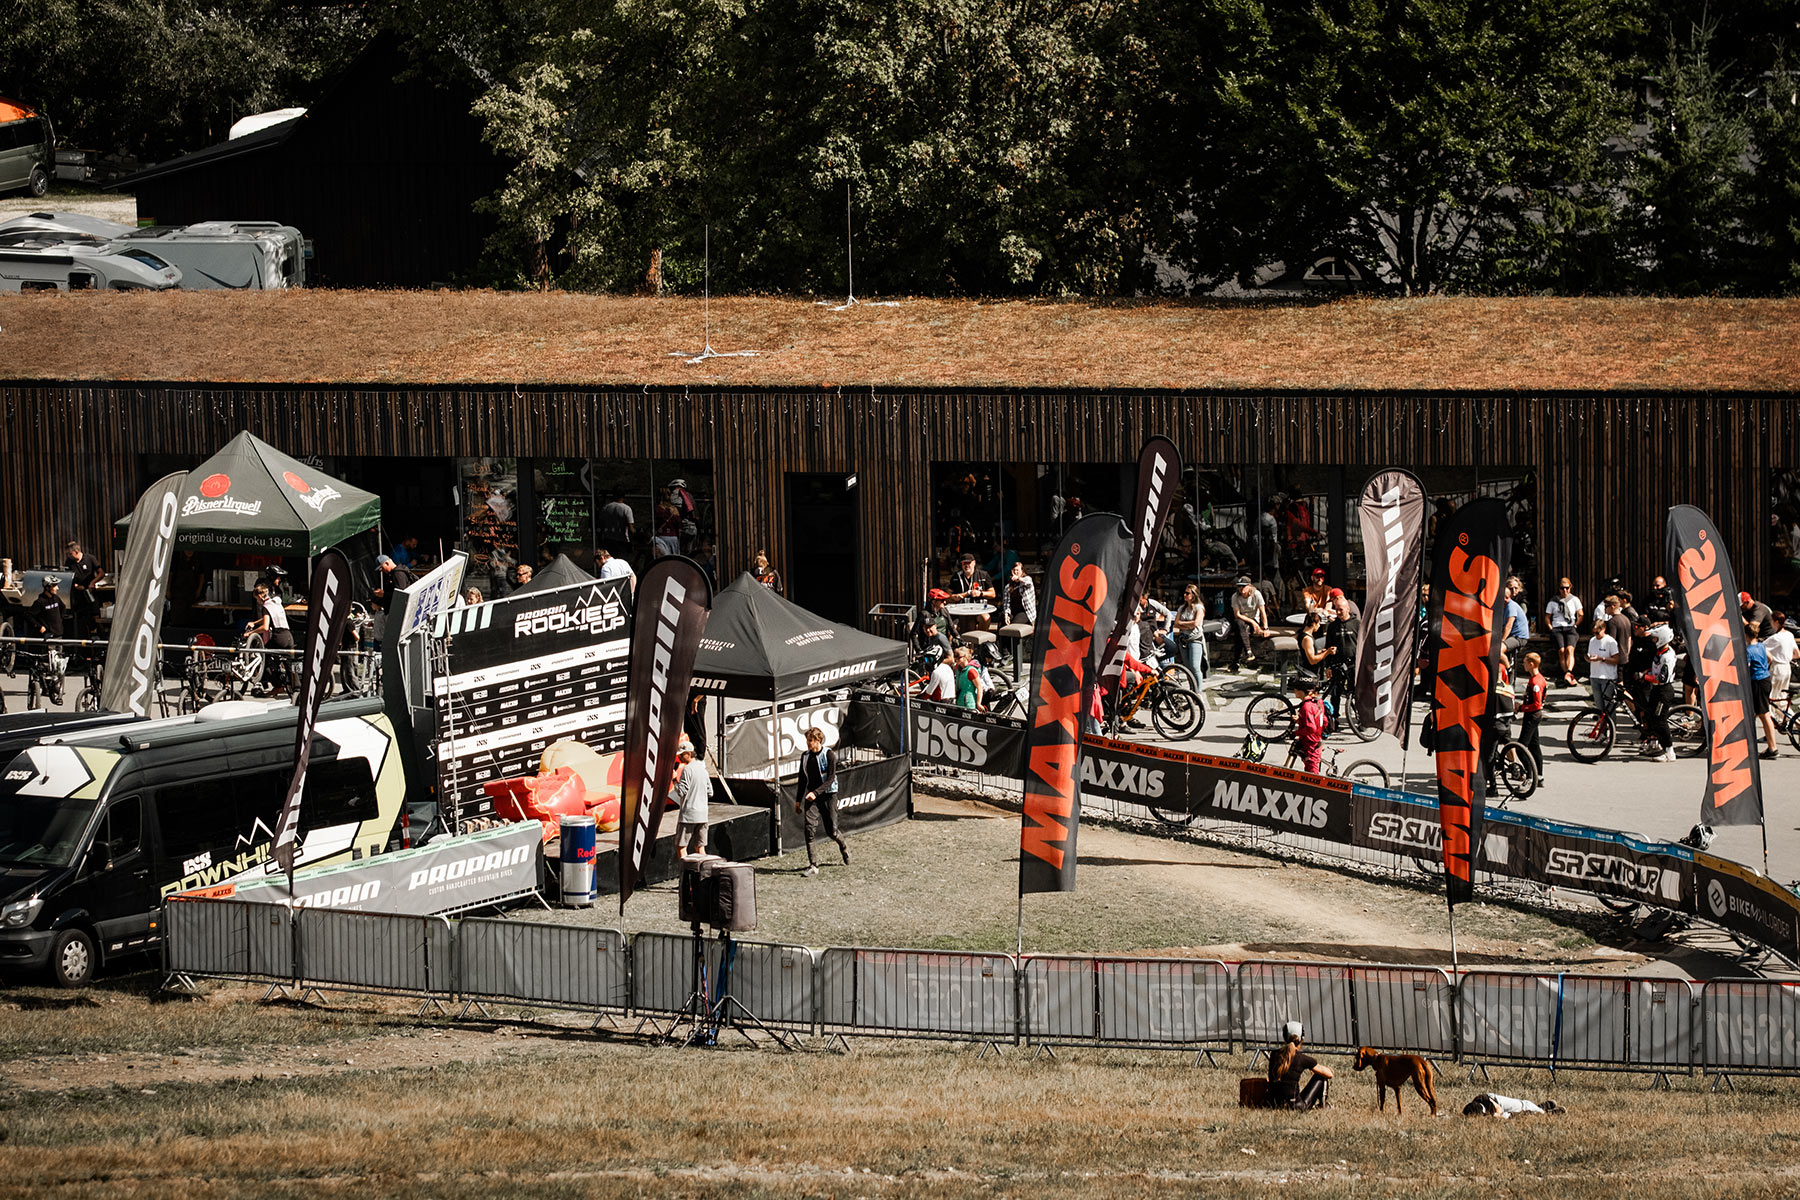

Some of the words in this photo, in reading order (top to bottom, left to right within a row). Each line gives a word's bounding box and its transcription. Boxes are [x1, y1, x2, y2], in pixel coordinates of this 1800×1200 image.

[178, 533, 214, 546] originál
[216, 534, 227, 545] už
[229, 535, 242, 545] od
[244, 535, 266, 547] roku
[268, 537, 293, 548] 1842
[129, 491, 178, 716] NORCO
[514, 601, 619, 638] ROOKIES
[515, 604, 568, 622] PROPAIN
[590, 615, 625, 635] CUP
[807, 659, 878, 686] PROPAIN
[632, 576, 686, 872] PROPAIN
[1080, 755, 1165, 798] AXXIS
[838, 791, 876, 810] PAIN
[1211, 779, 1329, 829] MAXXIS
[1369, 813, 1404, 840] SR
[408, 845, 530, 891] PROPAIN
[1546, 849, 1585, 877] SR
[1584, 853, 1660, 894] SUNTOUR
